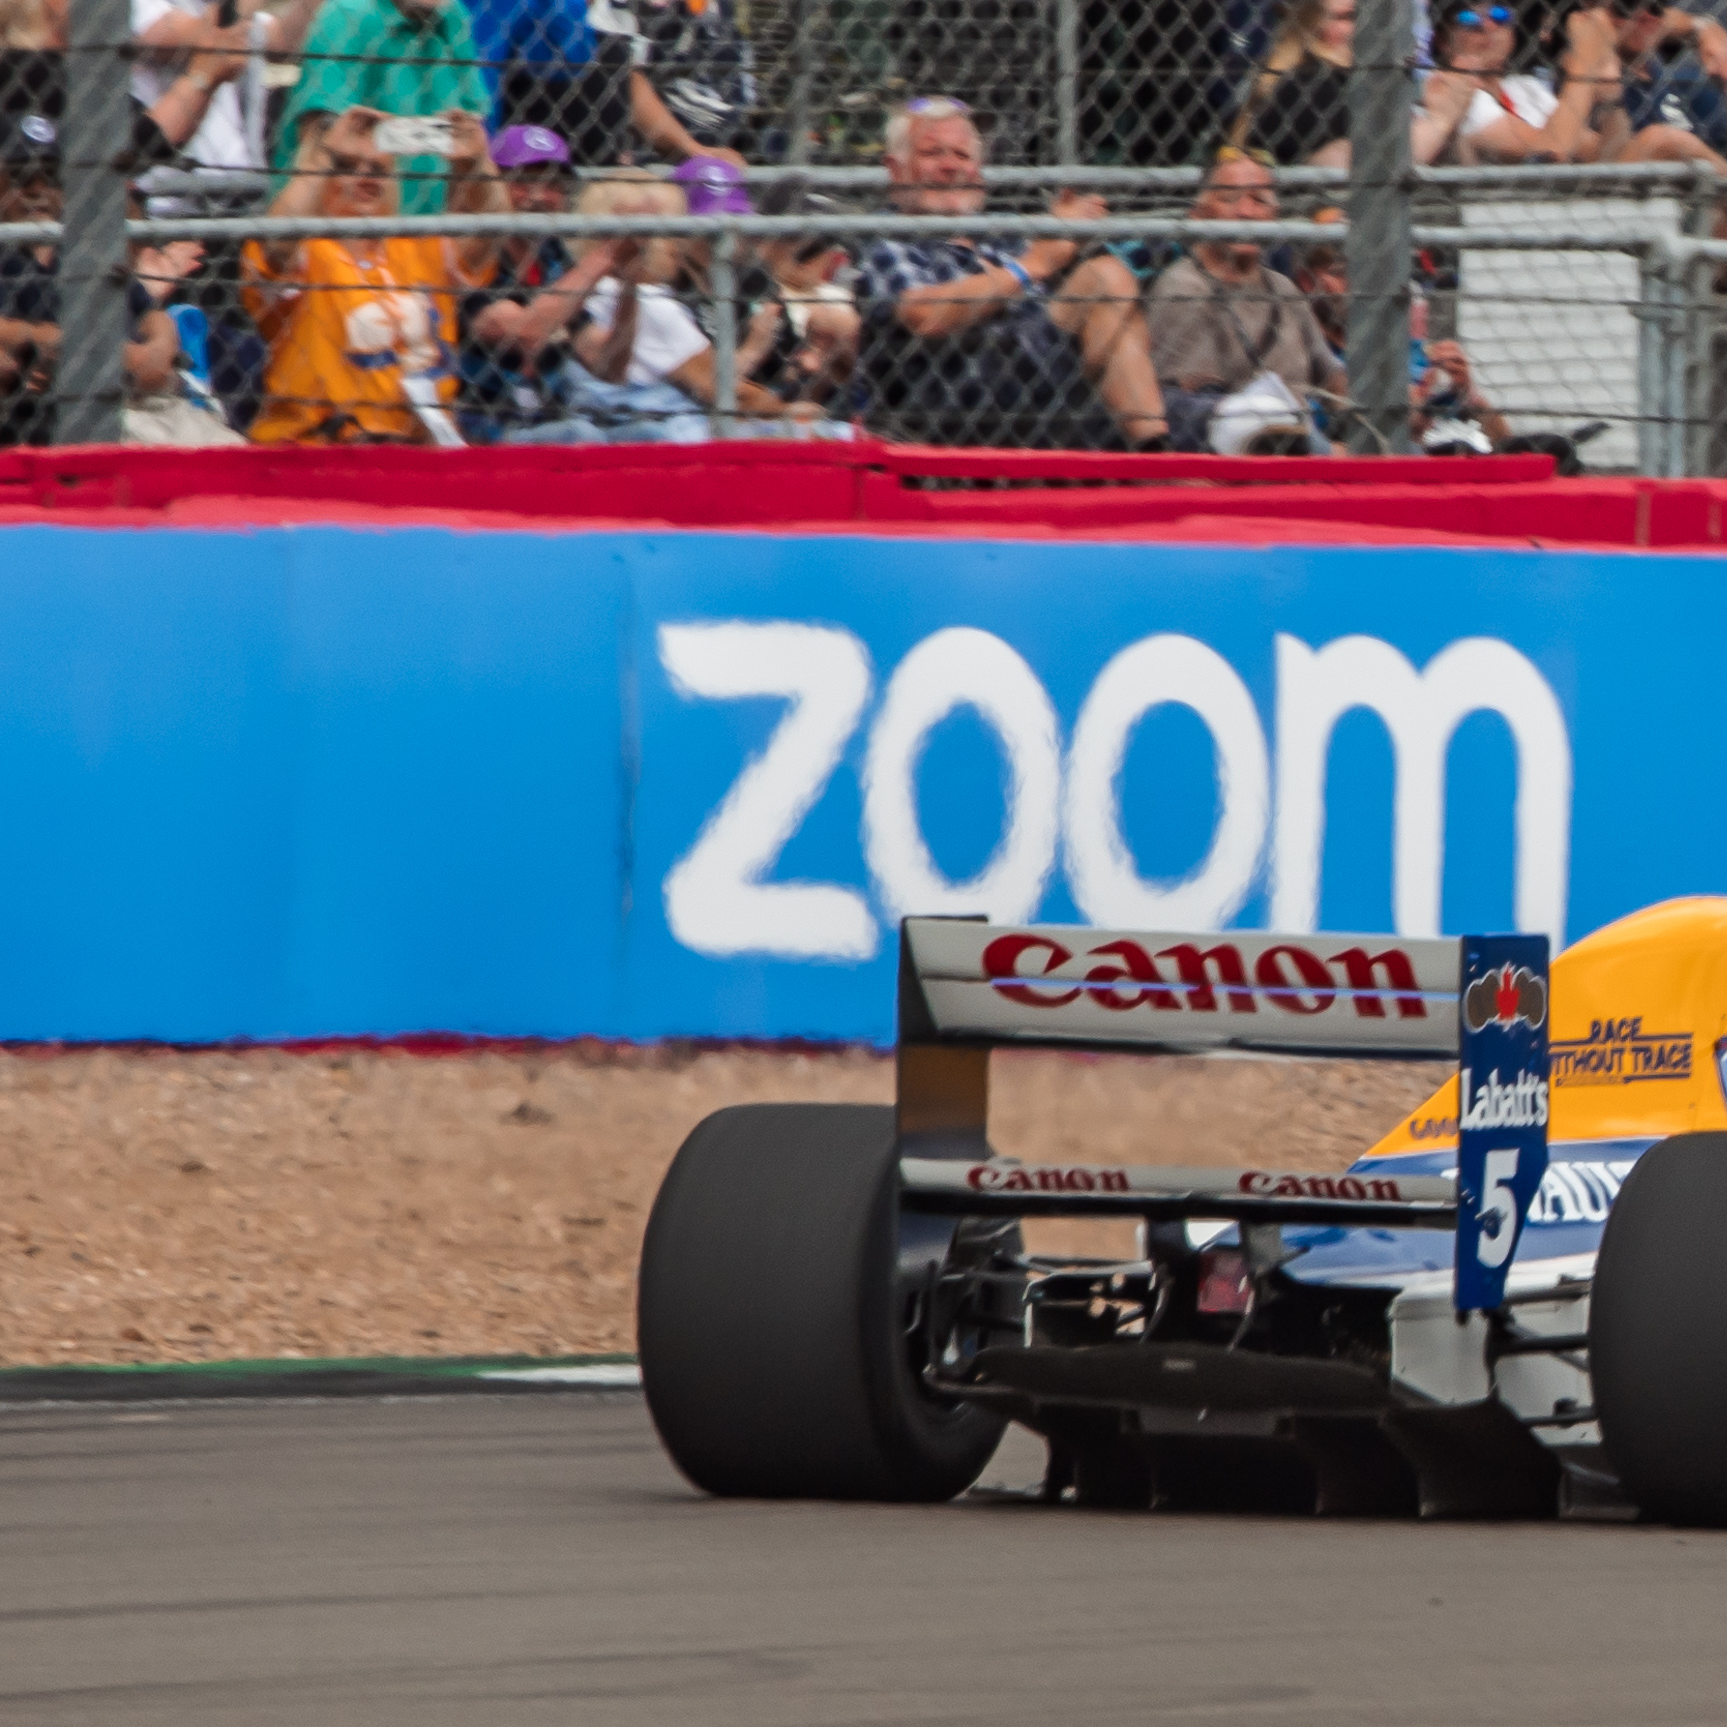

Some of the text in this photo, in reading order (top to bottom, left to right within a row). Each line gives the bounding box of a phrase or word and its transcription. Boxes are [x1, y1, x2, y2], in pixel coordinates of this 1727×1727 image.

[658, 619, 1572, 963] zoom
[982, 933, 1428, 1019] Canon
[1591, 1016, 1643, 1044] RACE
[1631, 1043, 1692, 1073] TRACE
[1460, 1068, 1548, 1130] Labatt's
[966, 1165, 1132, 1193] Canon
[1237, 1171, 1401, 1202] Canon
[1477, 1148, 1520, 1268] 5
